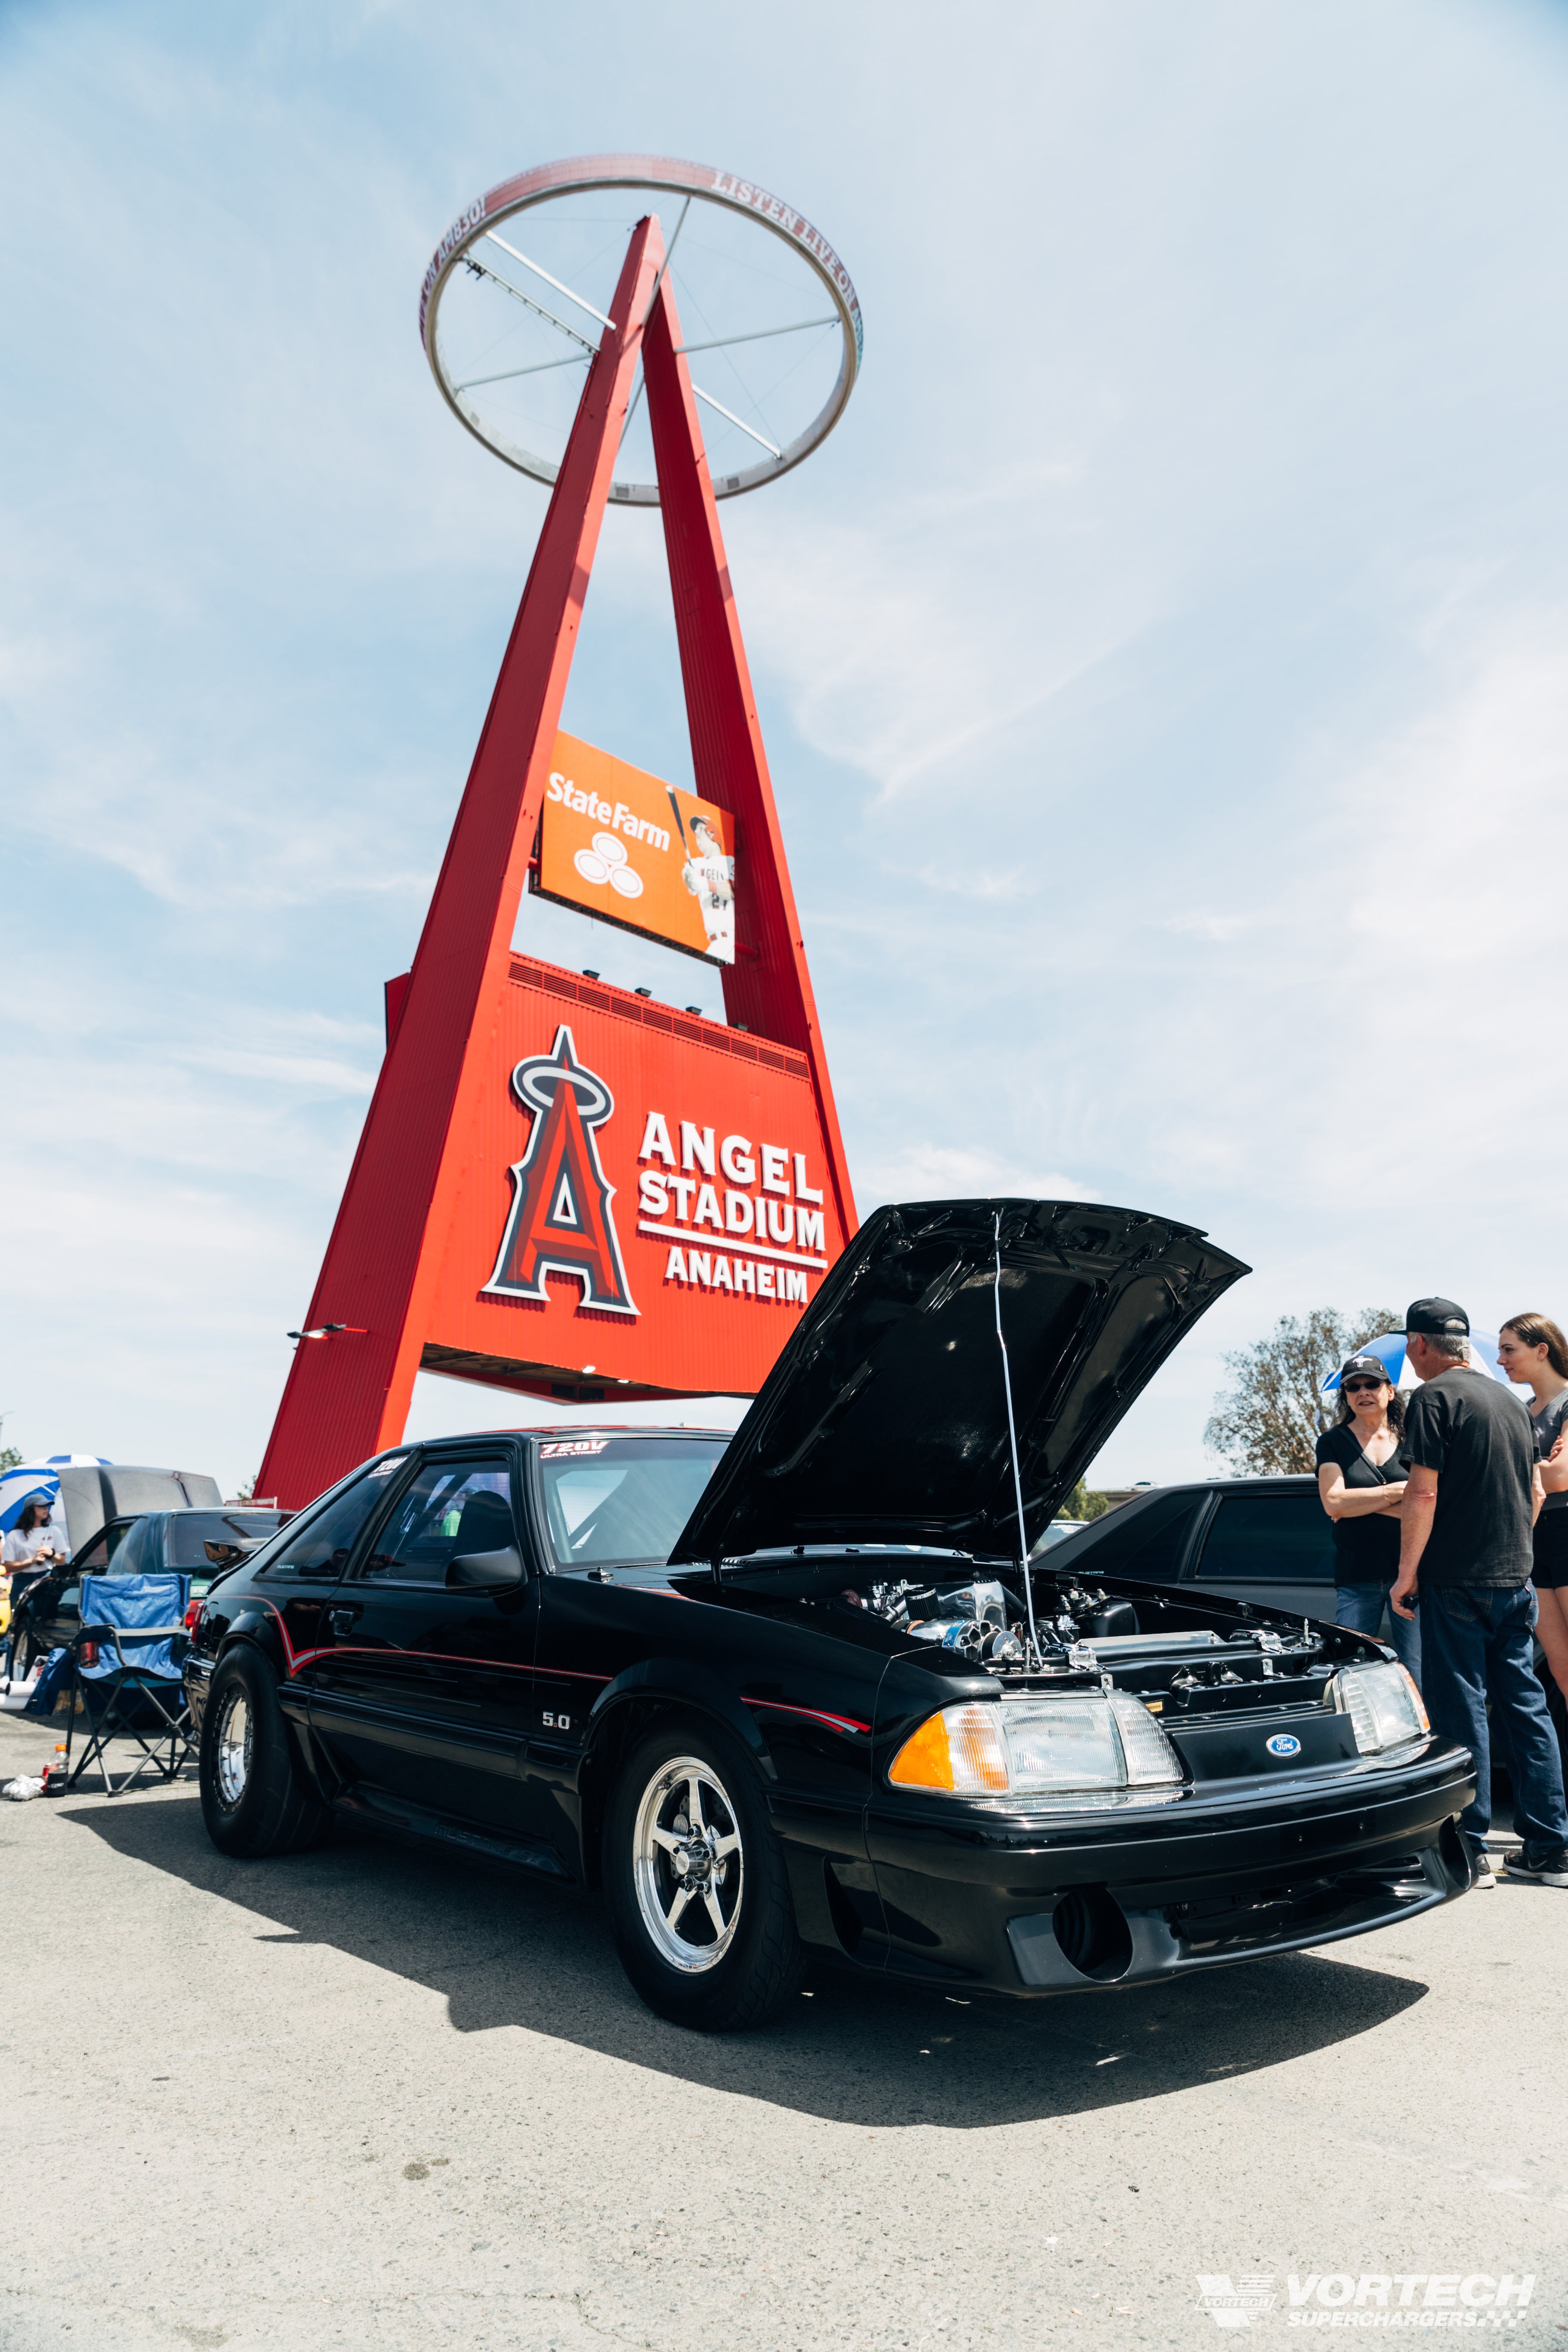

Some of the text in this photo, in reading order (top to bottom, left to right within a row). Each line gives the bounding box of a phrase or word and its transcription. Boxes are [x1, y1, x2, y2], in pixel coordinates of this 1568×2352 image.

[711, 172, 801, 231] LISTEN
[799, 221, 839, 274] LIVE
[639, 1111, 824, 1204] ANGEL
[639, 1170, 826, 1251] STADIUM
[665, 1246, 808, 1303] ANAHEIM
[541, 1441, 610, 1455] 720V
[542, 1711, 570, 1730] 5.0
[1276, 1738, 1293, 1751] Ford
